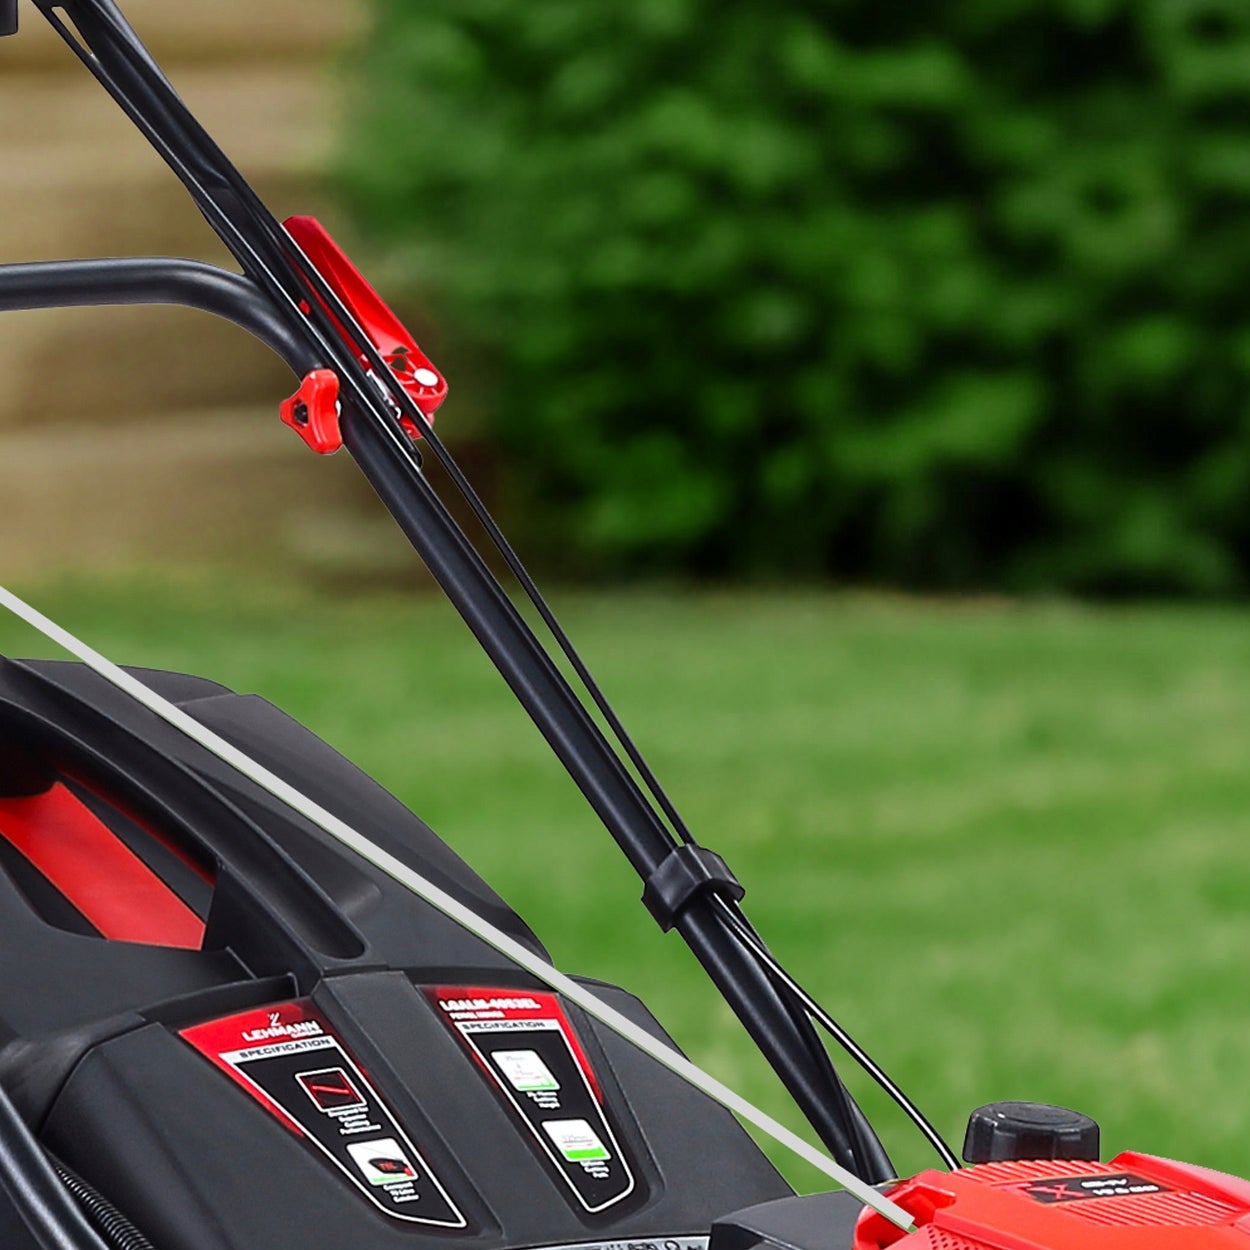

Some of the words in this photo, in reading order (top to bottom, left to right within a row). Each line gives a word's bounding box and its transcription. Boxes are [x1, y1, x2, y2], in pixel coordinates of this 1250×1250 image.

[241, 1020, 321, 1042] LEHMANN
[462, 1022, 546, 1031] SPECIFICATION
[239, 1038, 332, 1059] SPECIFICATION
